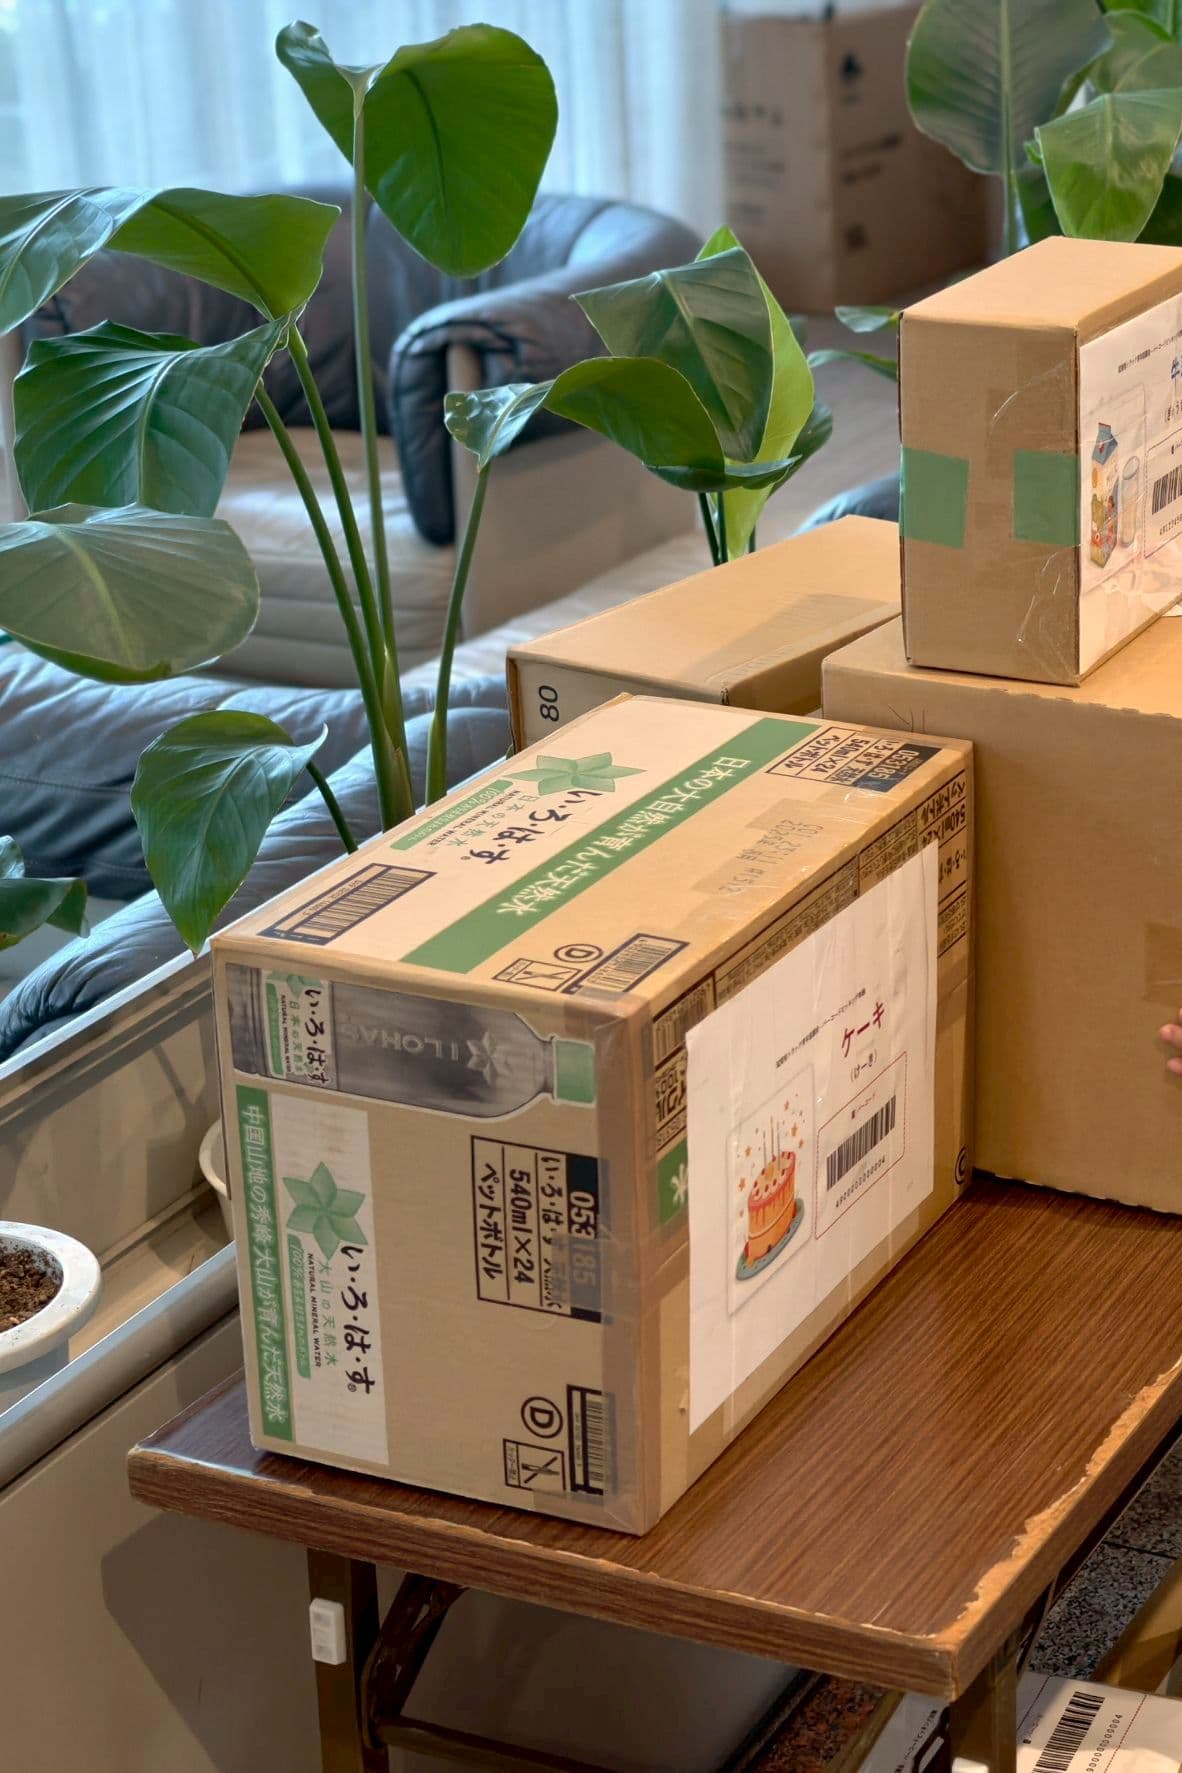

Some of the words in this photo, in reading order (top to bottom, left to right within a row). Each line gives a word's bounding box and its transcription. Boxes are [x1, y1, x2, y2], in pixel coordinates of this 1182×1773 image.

[779, 734, 843, 769] ペットボトル
[865, 749, 921, 779] 053185
[451, 809, 489, 829] MINERAL
[483, 790, 522, 809] NATURAL
[424, 830, 457, 845] WATER
[444, 794, 541, 847] 日本の天然水
[490, 755, 752, 917] 日本の大自然が育んだ天然水
[842, 1001, 884, 1058] ケーキ
[476, 1160, 503, 1282] ペットボトル
[507, 1167, 534, 1285] 540ml×24
[569, 1188, 596, 1287] 053185
[307, 1252, 316, 1293] NATURAL
[310, 1295, 319, 1335] MINERAL
[318, 1260, 338, 1367] 大山の天然水
[313, 1337, 321, 1368] WATER
